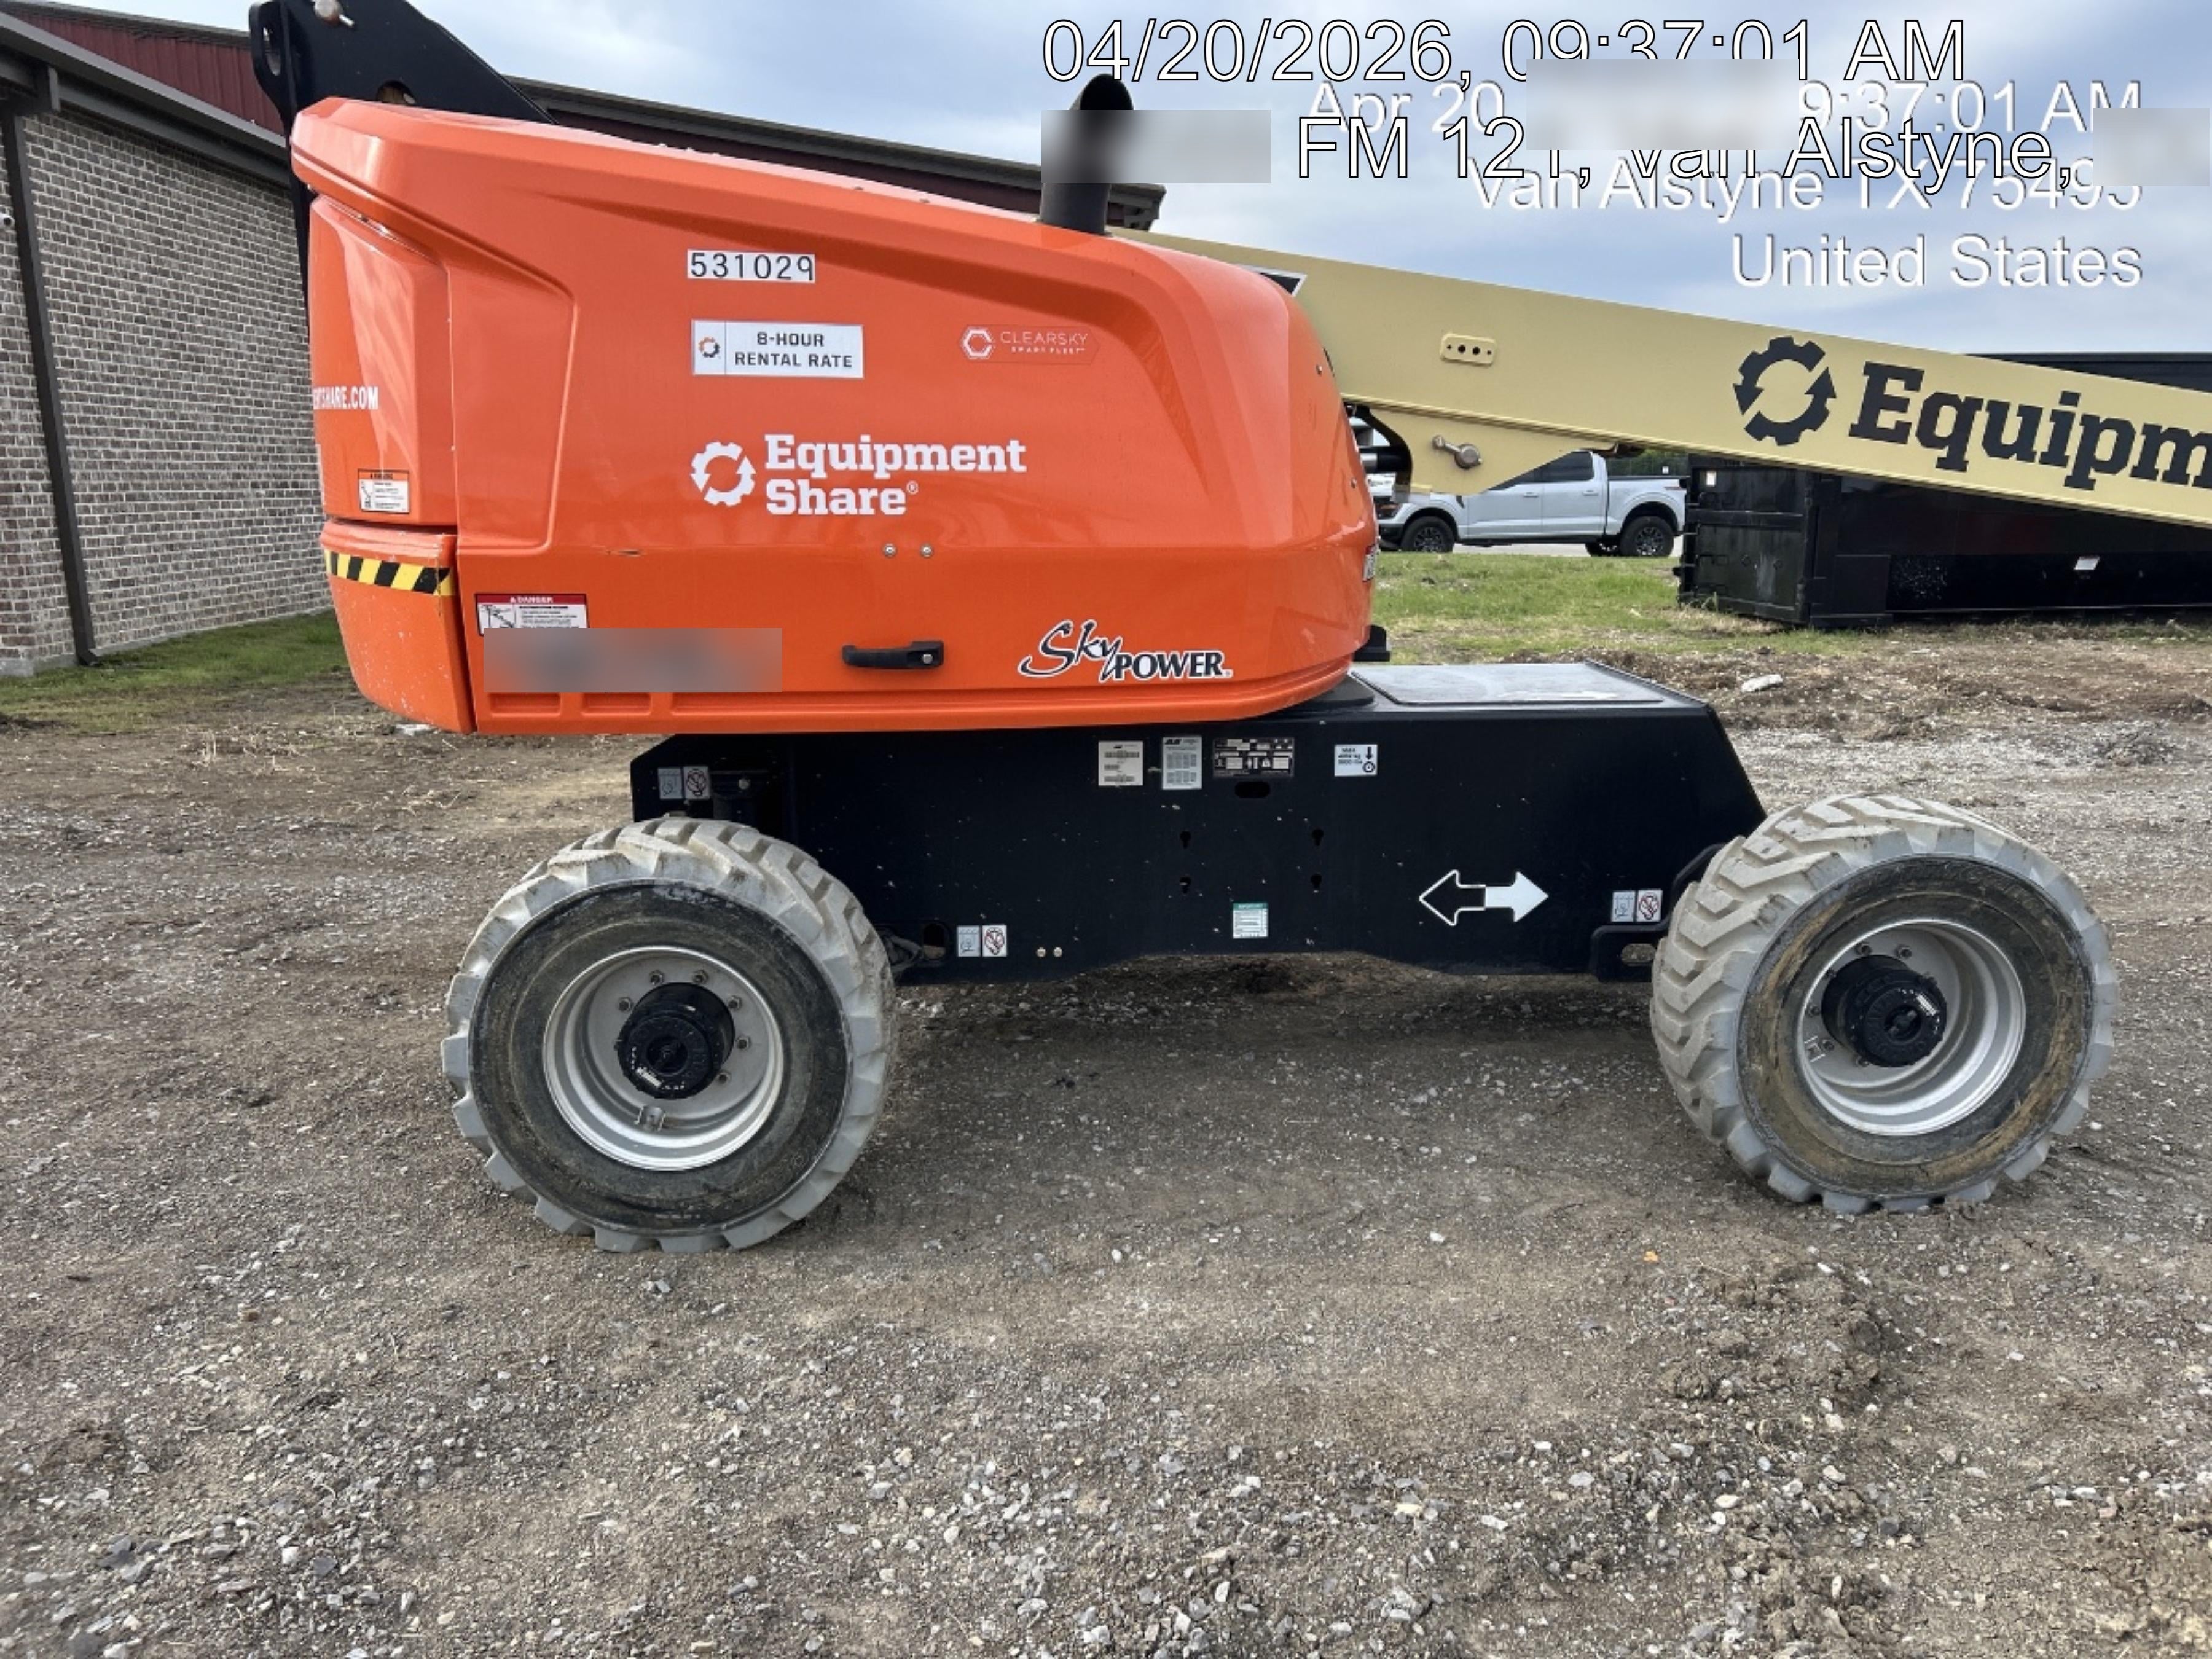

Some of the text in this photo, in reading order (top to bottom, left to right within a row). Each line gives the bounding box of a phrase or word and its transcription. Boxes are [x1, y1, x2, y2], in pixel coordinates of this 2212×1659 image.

[690, 251, 814, 281] 531029
[756, 331, 825, 347] 8-HOUR
[1000, 331, 1088, 345] CLEARSKY
[734, 351, 853, 368] RENTAL RATE
[764, 434, 1028, 479] Equipment
